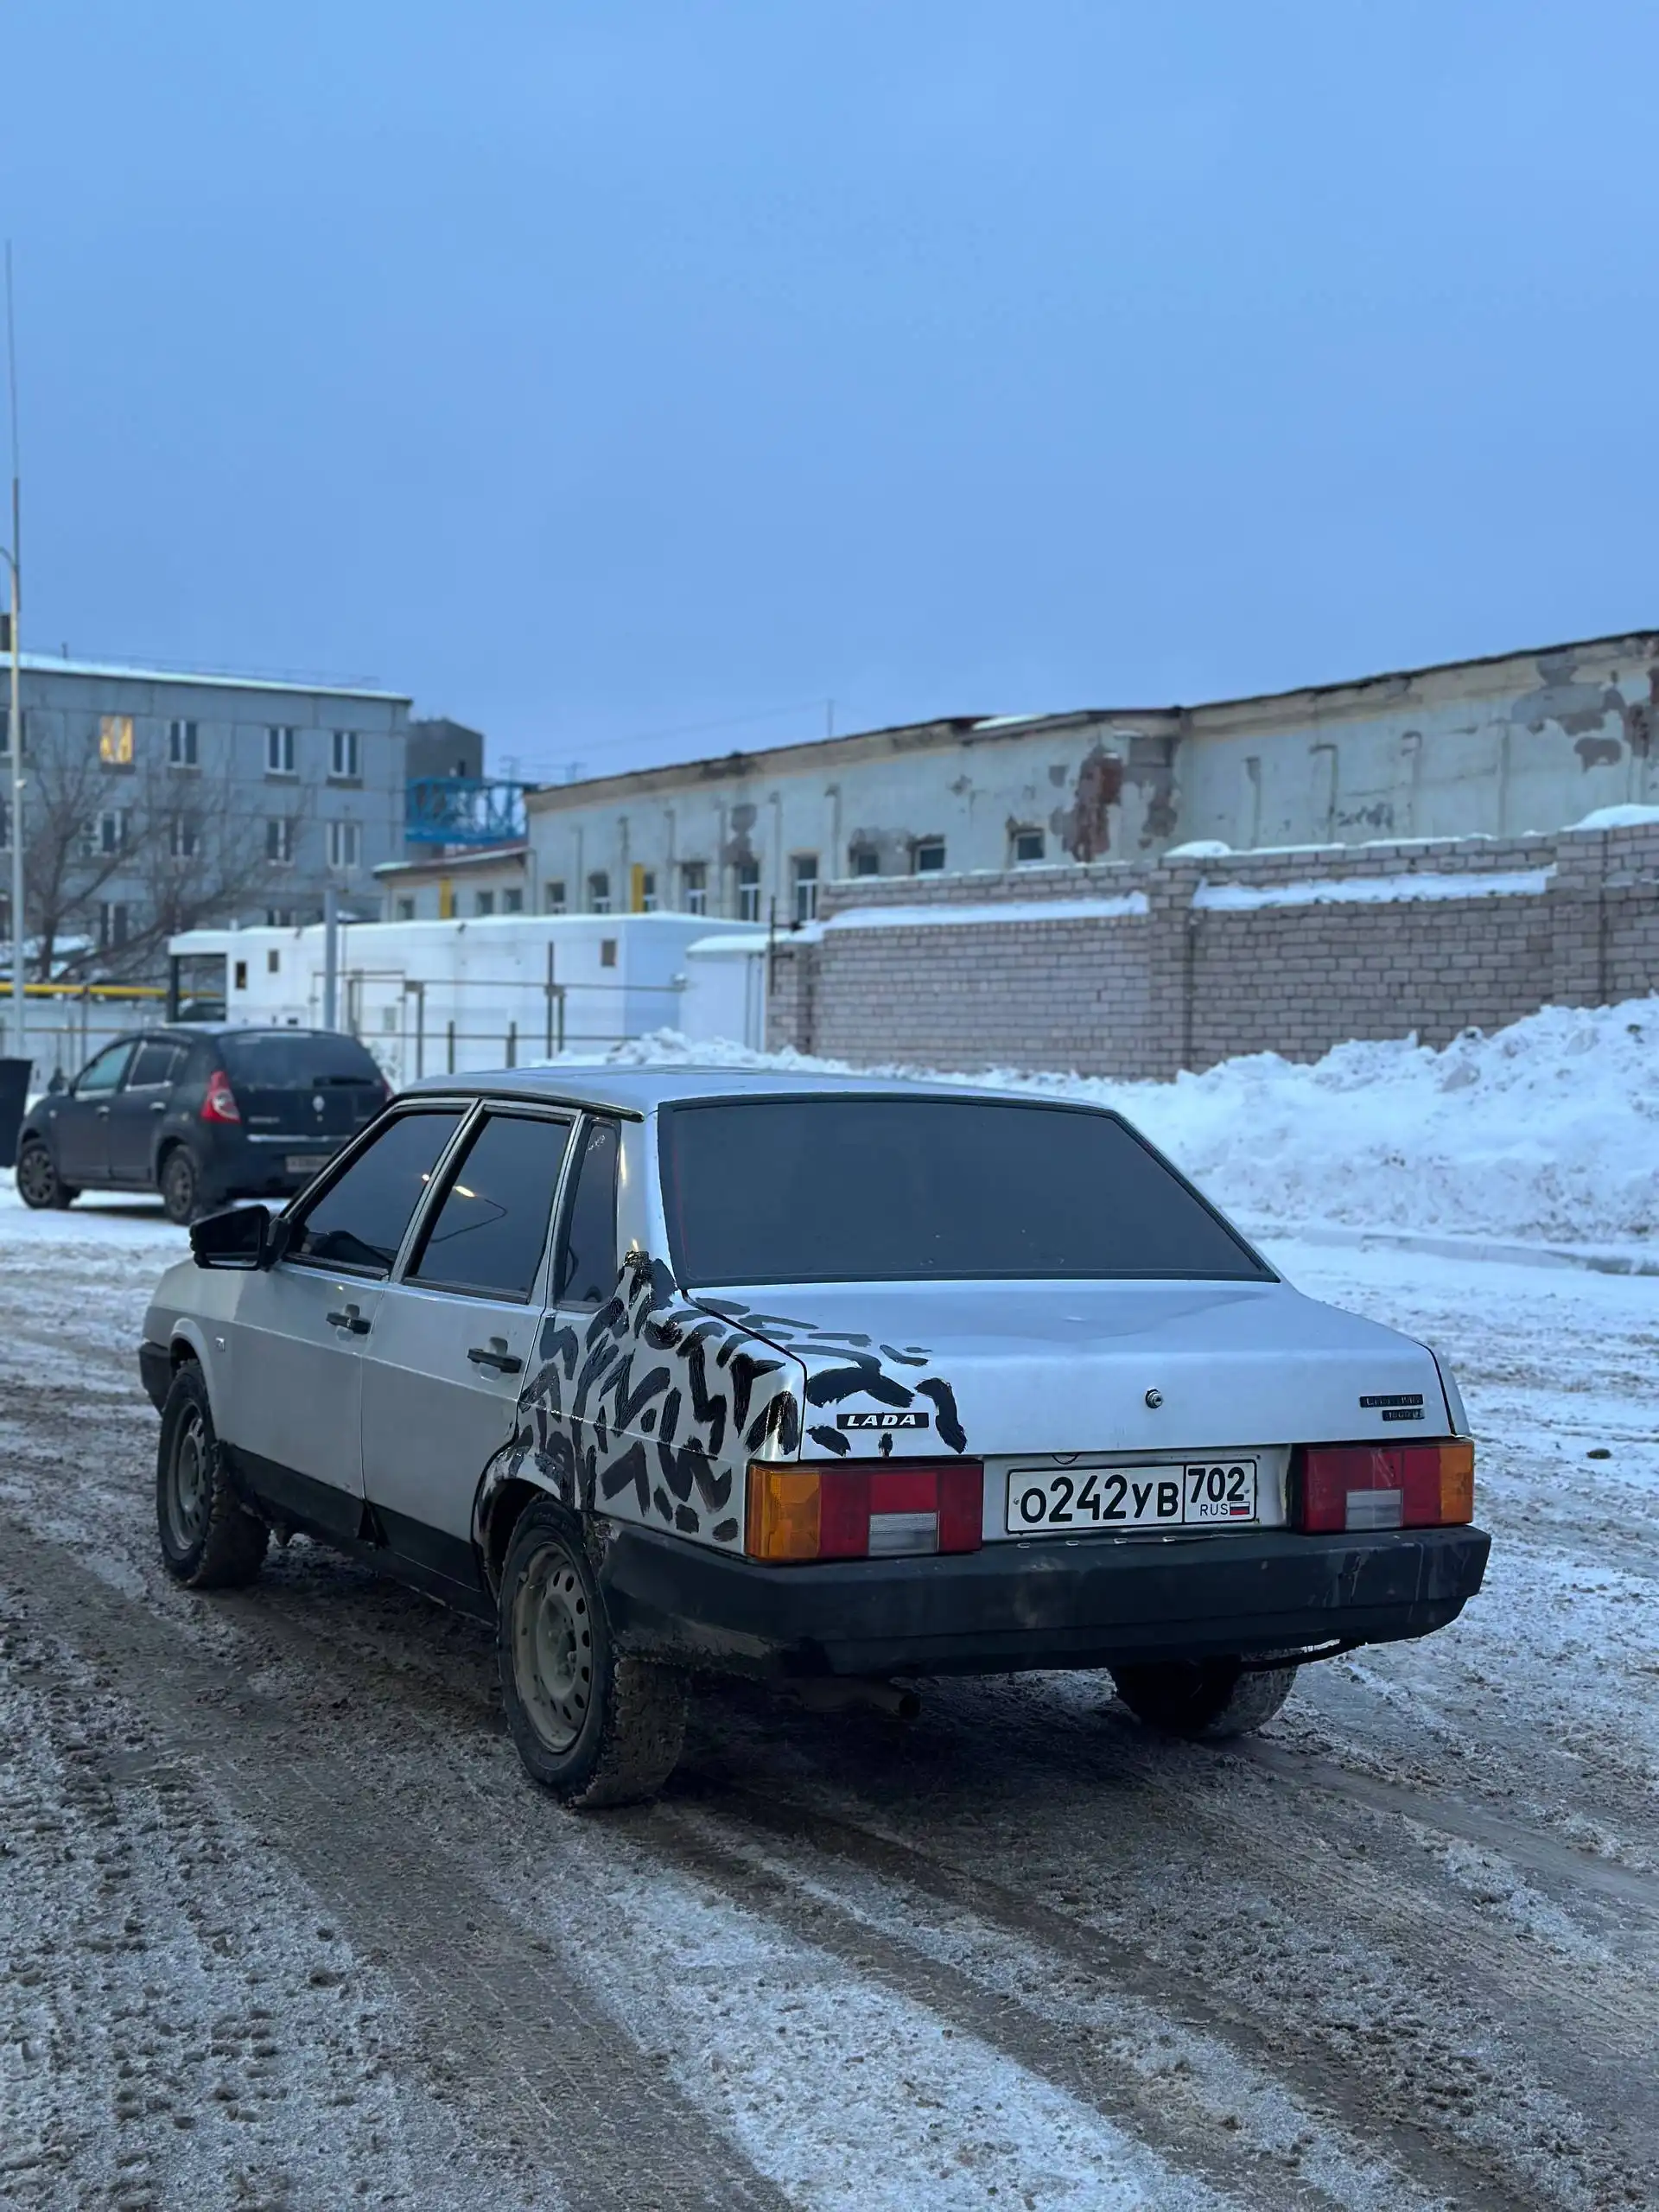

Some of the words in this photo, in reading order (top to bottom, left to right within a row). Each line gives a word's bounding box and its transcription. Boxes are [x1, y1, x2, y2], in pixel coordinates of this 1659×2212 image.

[846, 1414, 916, 1427] LADA
[1187, 1466, 1245, 1503] 702
[1199, 1503, 1229, 1516] RUS
